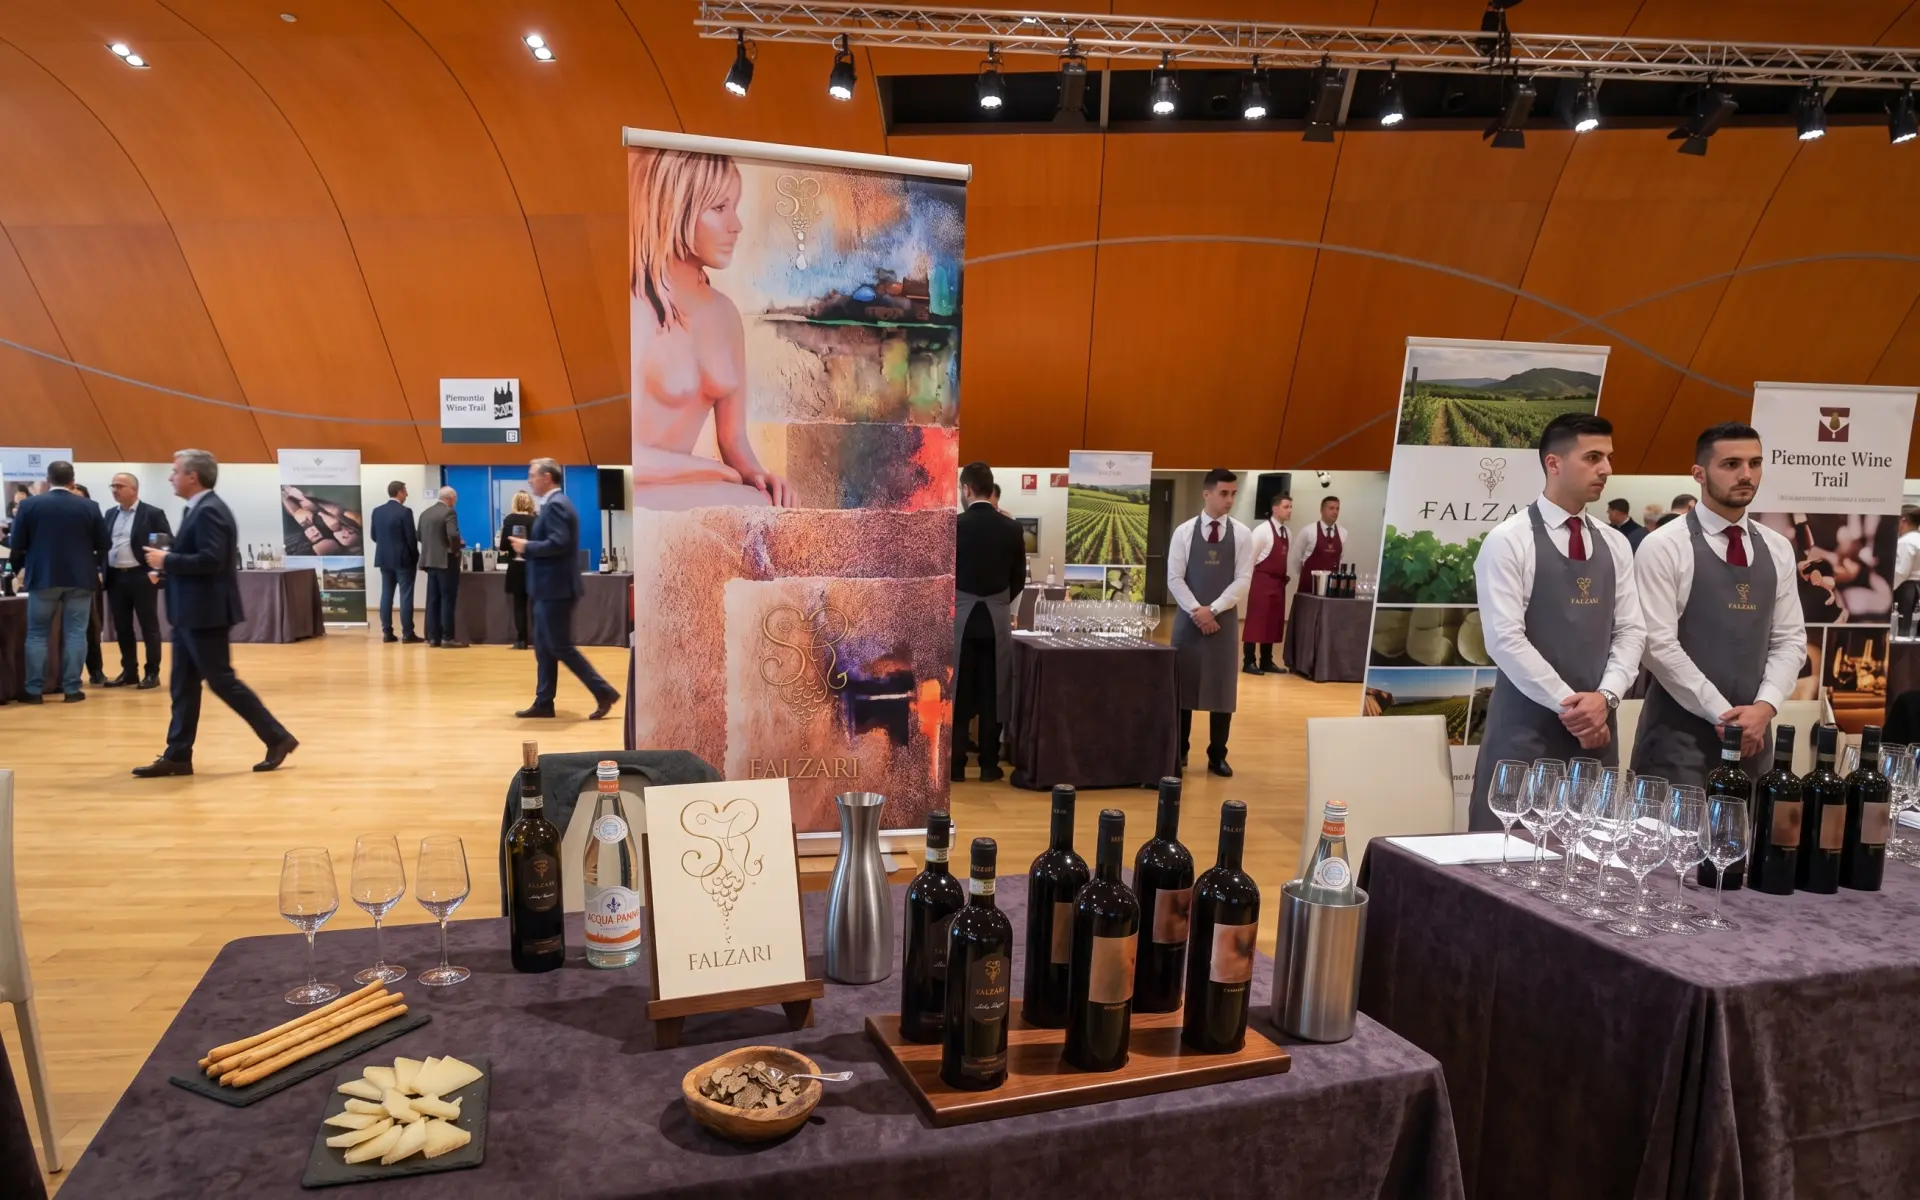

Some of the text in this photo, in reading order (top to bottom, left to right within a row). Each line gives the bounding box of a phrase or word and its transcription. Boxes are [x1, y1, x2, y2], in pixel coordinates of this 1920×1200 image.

[446, 403, 467, 412] Wine
[468, 403, 487, 412] Trail
[1771, 449, 1893, 468] Piemonte Wine
[1811, 471, 1849, 488] Trail
[1418, 501, 1531, 522] FALZA
[749, 757, 861, 779] FALZARI
[587, 912, 614, 927] ACQUA
[688, 944, 773, 971] FALZARI
